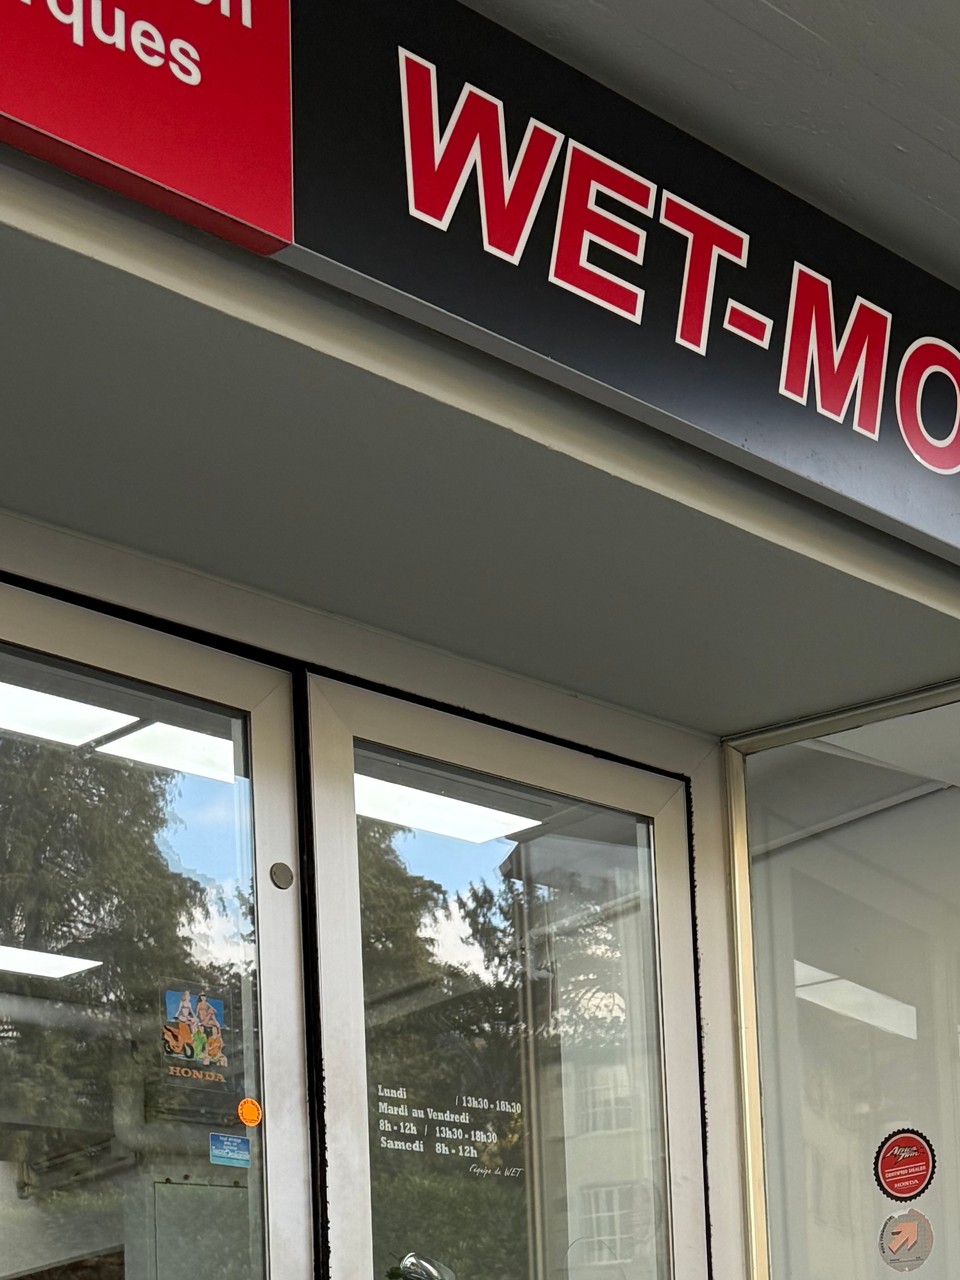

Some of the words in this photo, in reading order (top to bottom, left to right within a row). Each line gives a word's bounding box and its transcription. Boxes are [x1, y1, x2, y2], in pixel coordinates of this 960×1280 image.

[20, 0, 202, 86] ques
[168, 1066, 226, 1083] HONDA
[378, 1085, 407, 1099] Lundi
[378, 1102, 408, 1116] Mardi
[412, 1110, 425, 1118] au
[427, 1108, 470, 1123] Vendredi
[380, 1136, 424, 1152] Samedi
[504, 1167, 524, 1177] WET
